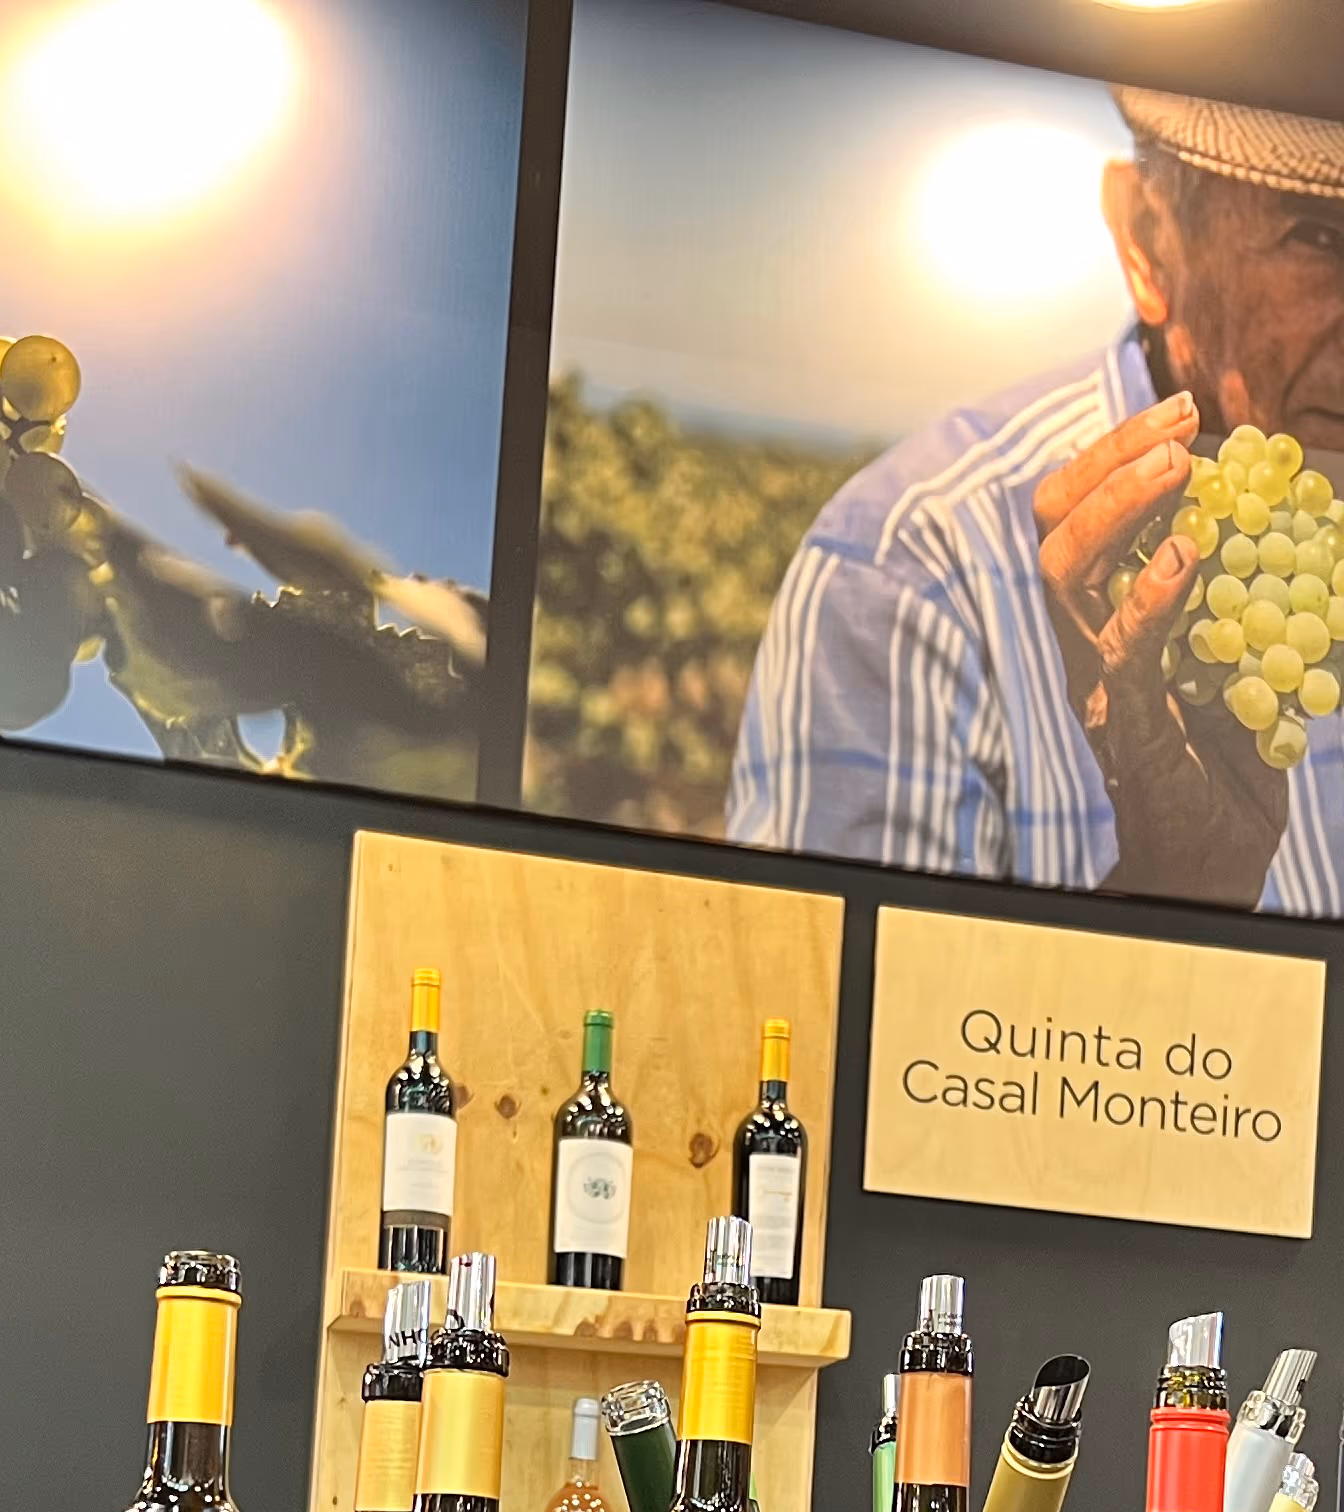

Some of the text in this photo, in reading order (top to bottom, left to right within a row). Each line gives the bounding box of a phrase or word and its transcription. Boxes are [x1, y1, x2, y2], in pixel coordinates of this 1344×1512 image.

[960, 1009, 1232, 1080] Quinta do
[902, 1059, 1282, 1142] Casal Monteiro
